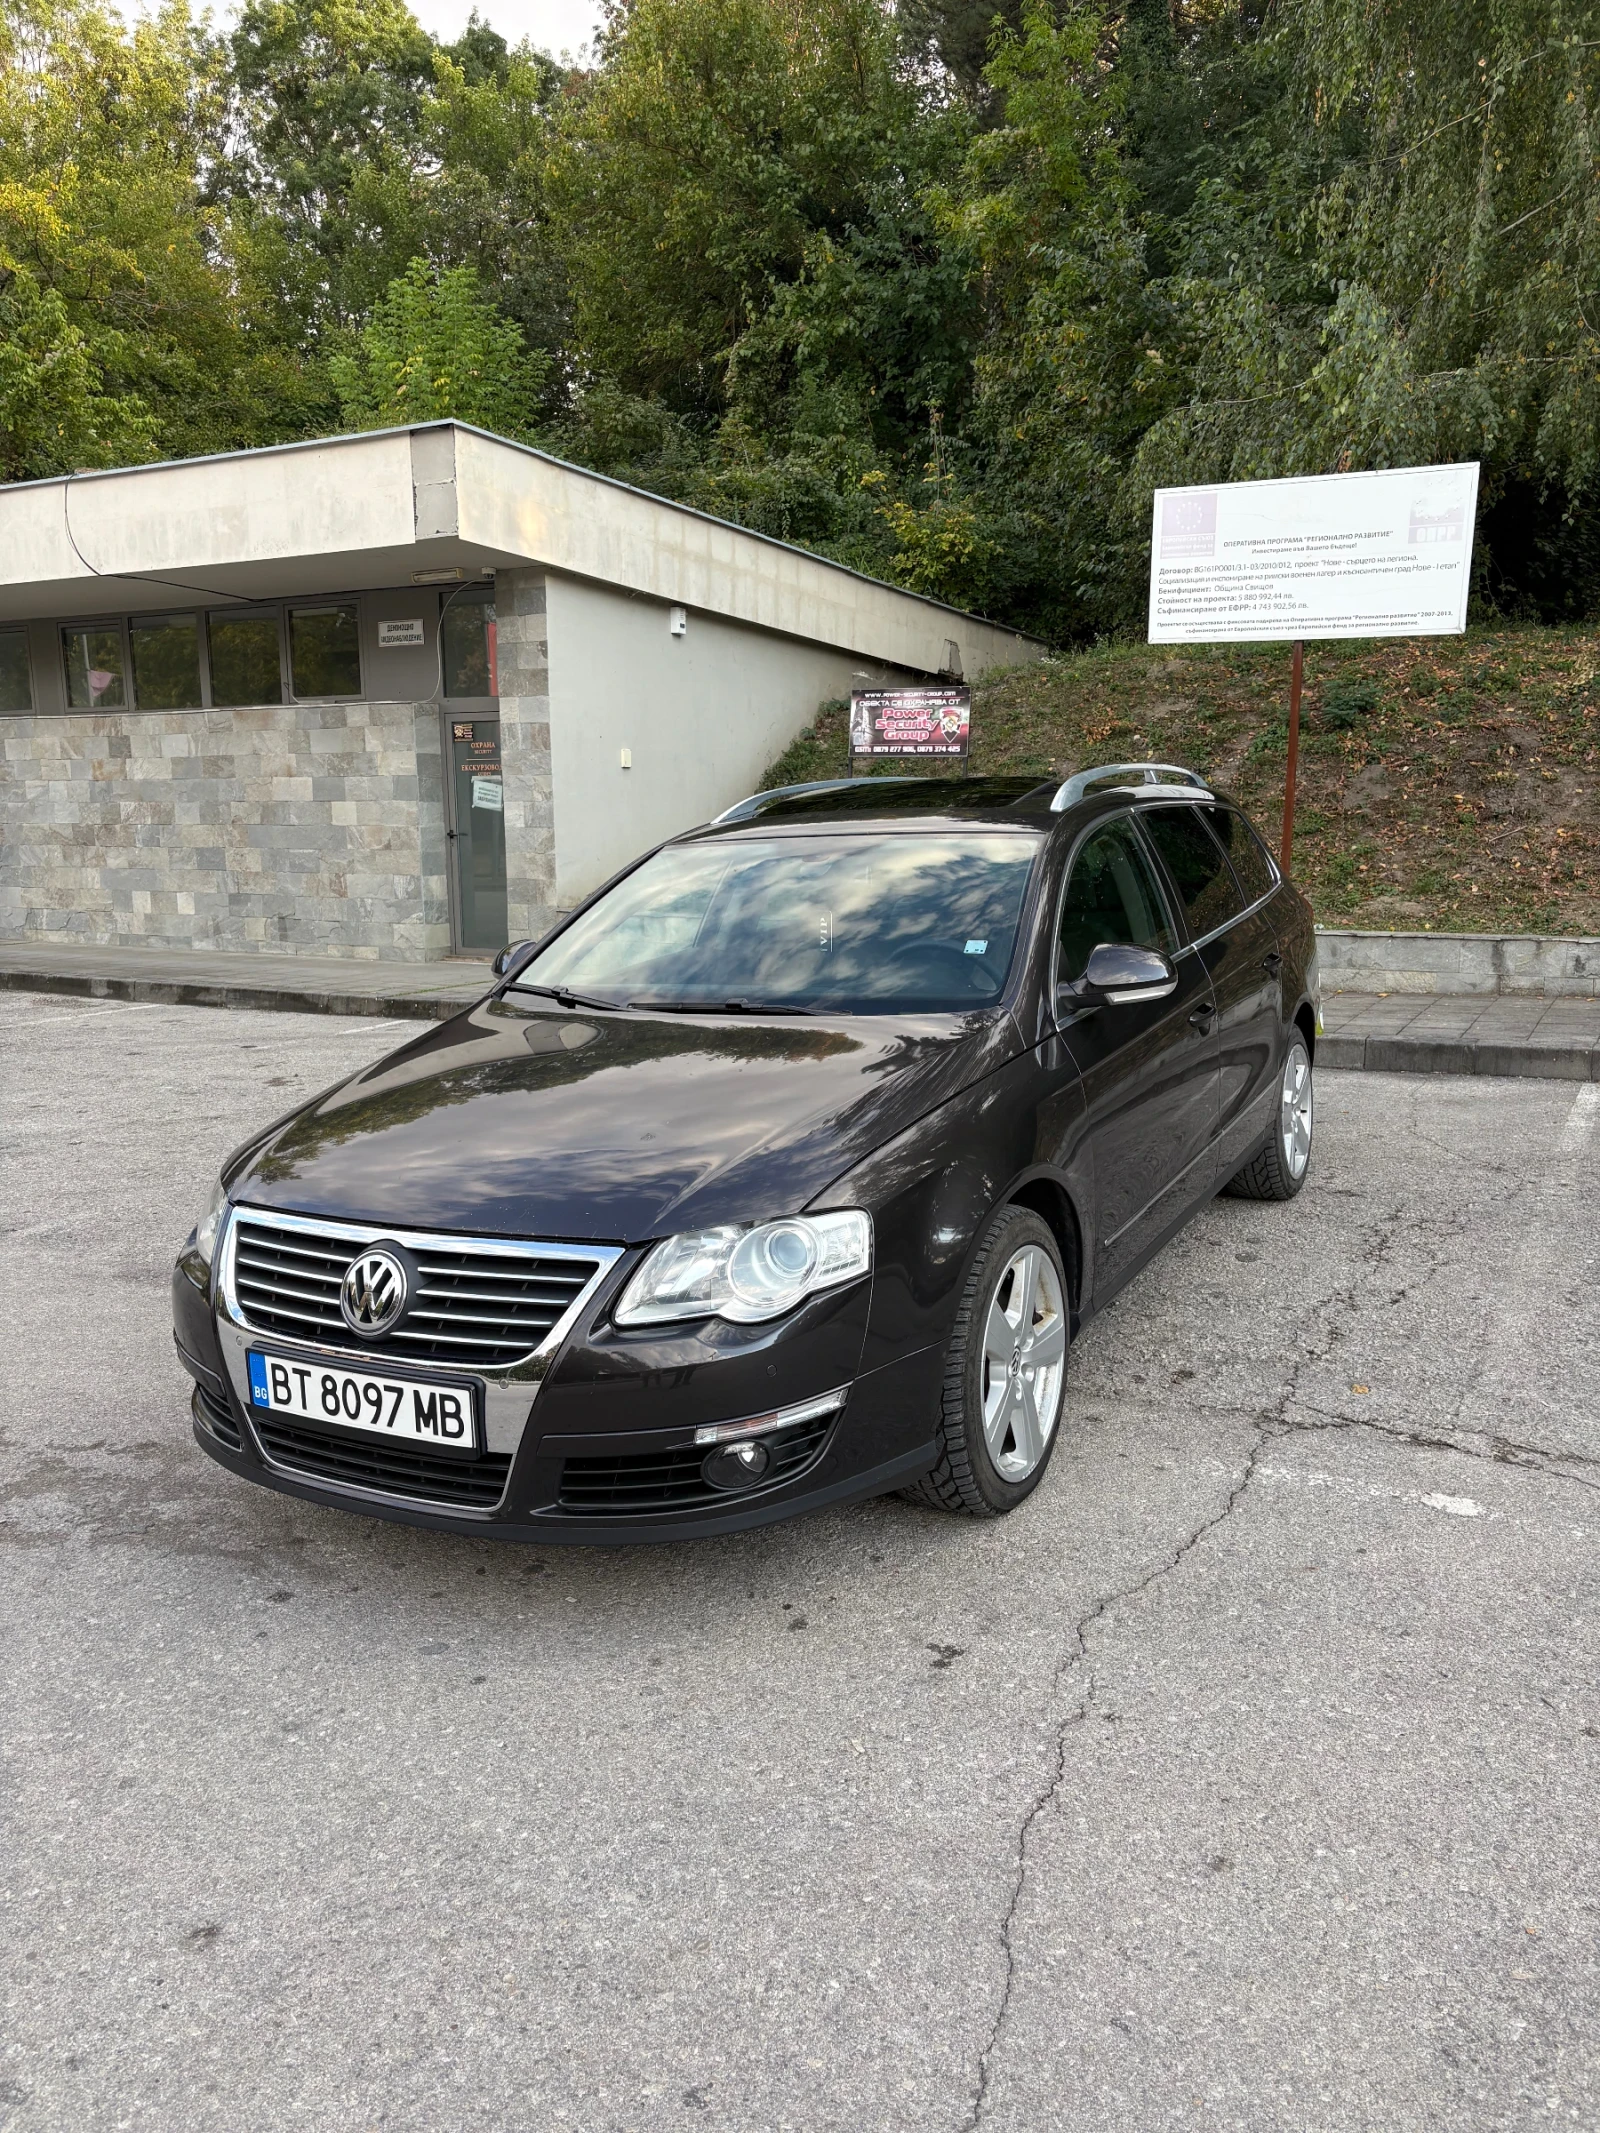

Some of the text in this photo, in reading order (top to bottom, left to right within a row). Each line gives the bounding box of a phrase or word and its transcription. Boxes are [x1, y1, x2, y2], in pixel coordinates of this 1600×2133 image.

[1224, 539, 1265, 547] ОПЕРАТИВНА
[1159, 568, 1193, 576] Договор:
[1295, 561, 1319, 569] проект
[1346, 557, 1376, 565] сърцето
[1343, 567, 1393, 575] късноантичен
[1394, 566, 1411, 574] град
[1158, 587, 1211, 595] Бенифициент:
[1157, 606, 1217, 615] Съфинансиране
[1273, 602, 1296, 610] 902,56
[882, 708, 933, 718] Power
[875, 719, 940, 731] Security
[883, 730, 930, 742] Group
[254, 1363, 465, 1439] BG BT 8097 MB
